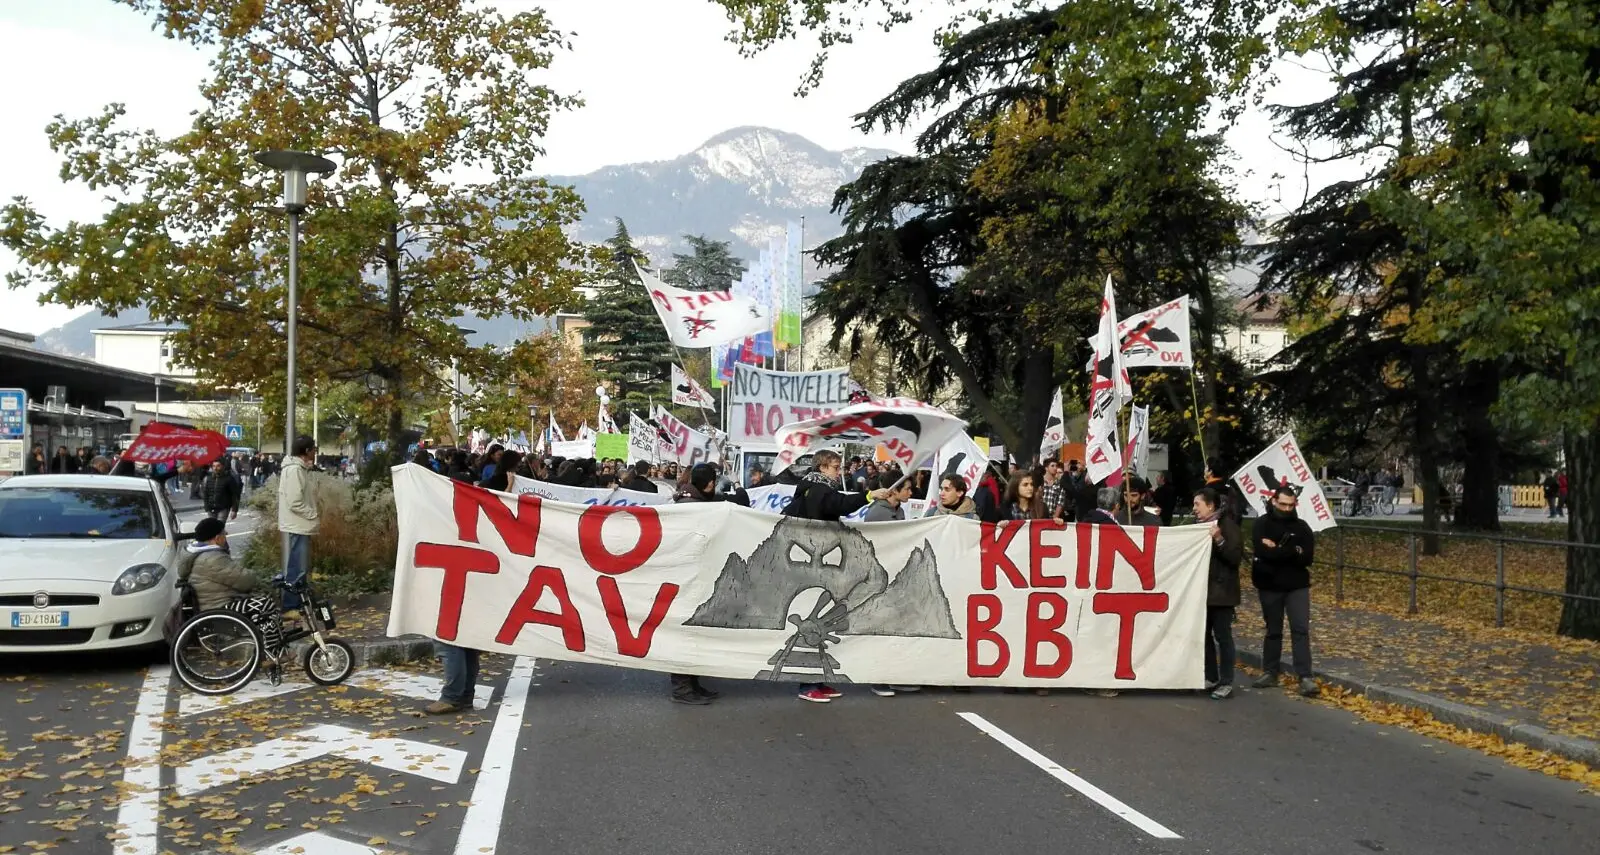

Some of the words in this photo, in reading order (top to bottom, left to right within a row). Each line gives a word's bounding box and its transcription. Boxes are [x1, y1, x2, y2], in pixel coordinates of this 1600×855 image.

[676, 288, 733, 310] TAV
[735, 365, 761, 396] NO
[765, 373, 849, 404] TRIVELLE
[744, 402, 784, 436] NO
[1240, 473, 1257, 495] NO
[1281, 441, 1311, 482] KEIN
[1310, 494, 1330, 521] BBT
[452, 479, 663, 576] NO
[979, 520, 1160, 591] KEIN
[413, 541, 680, 658] TAV
[966, 591, 1170, 680] BBT
